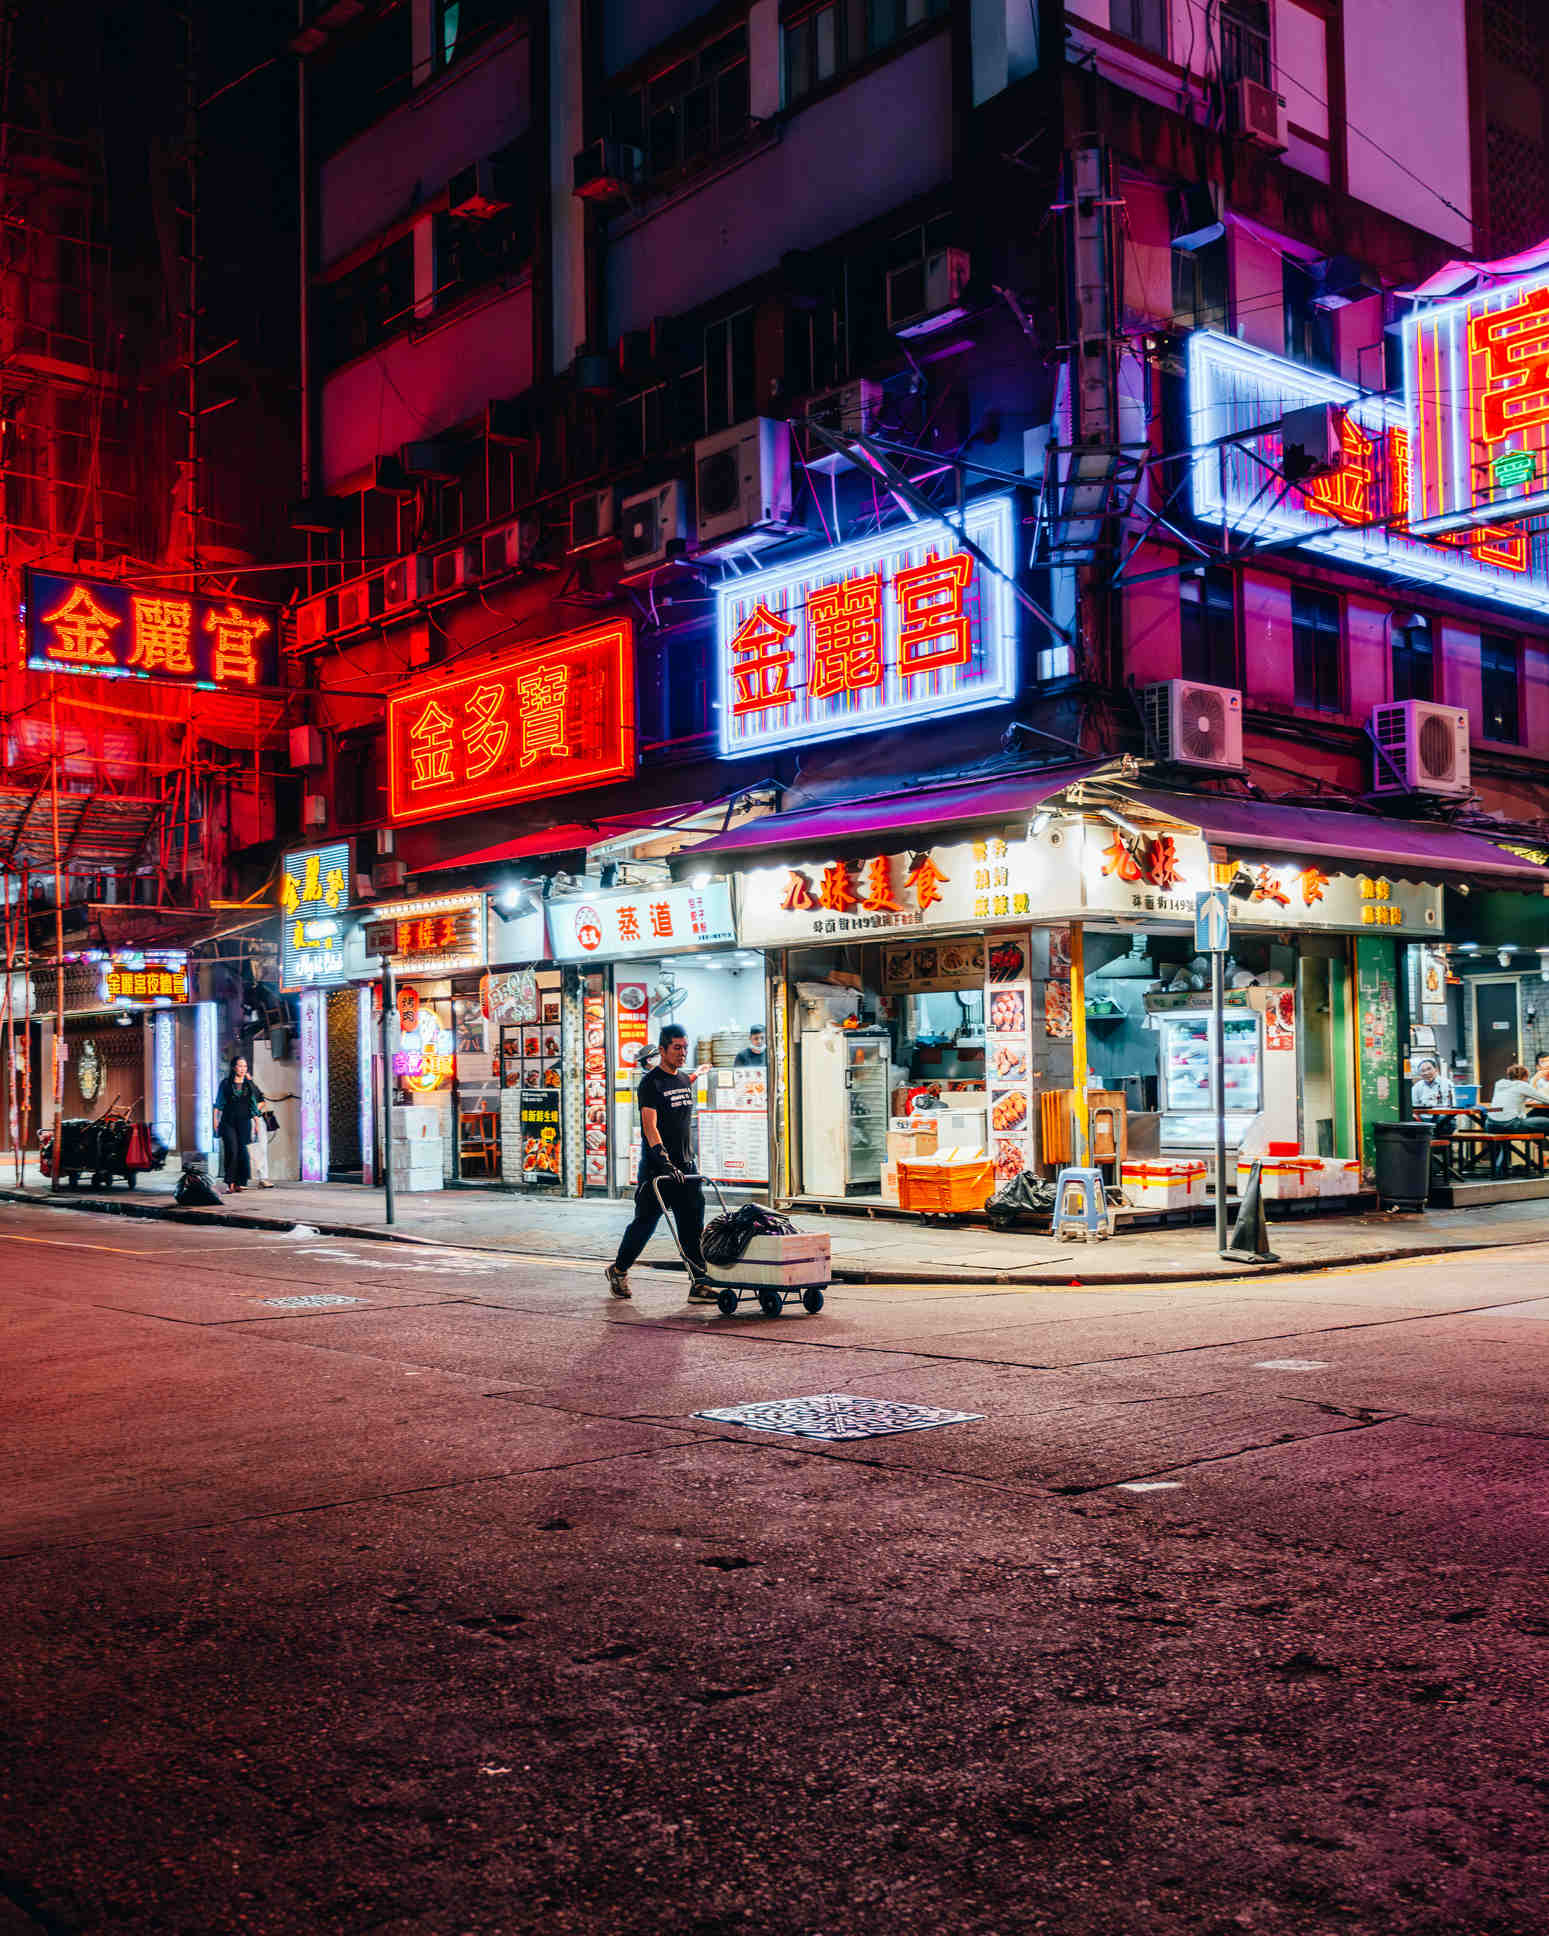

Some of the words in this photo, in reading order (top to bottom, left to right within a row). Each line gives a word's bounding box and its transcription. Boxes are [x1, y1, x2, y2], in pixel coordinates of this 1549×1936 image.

[731, 552, 974, 717] 金麗宮
[410, 665, 569, 791] 金多寶
[616, 901, 674, 942] 蒸道
